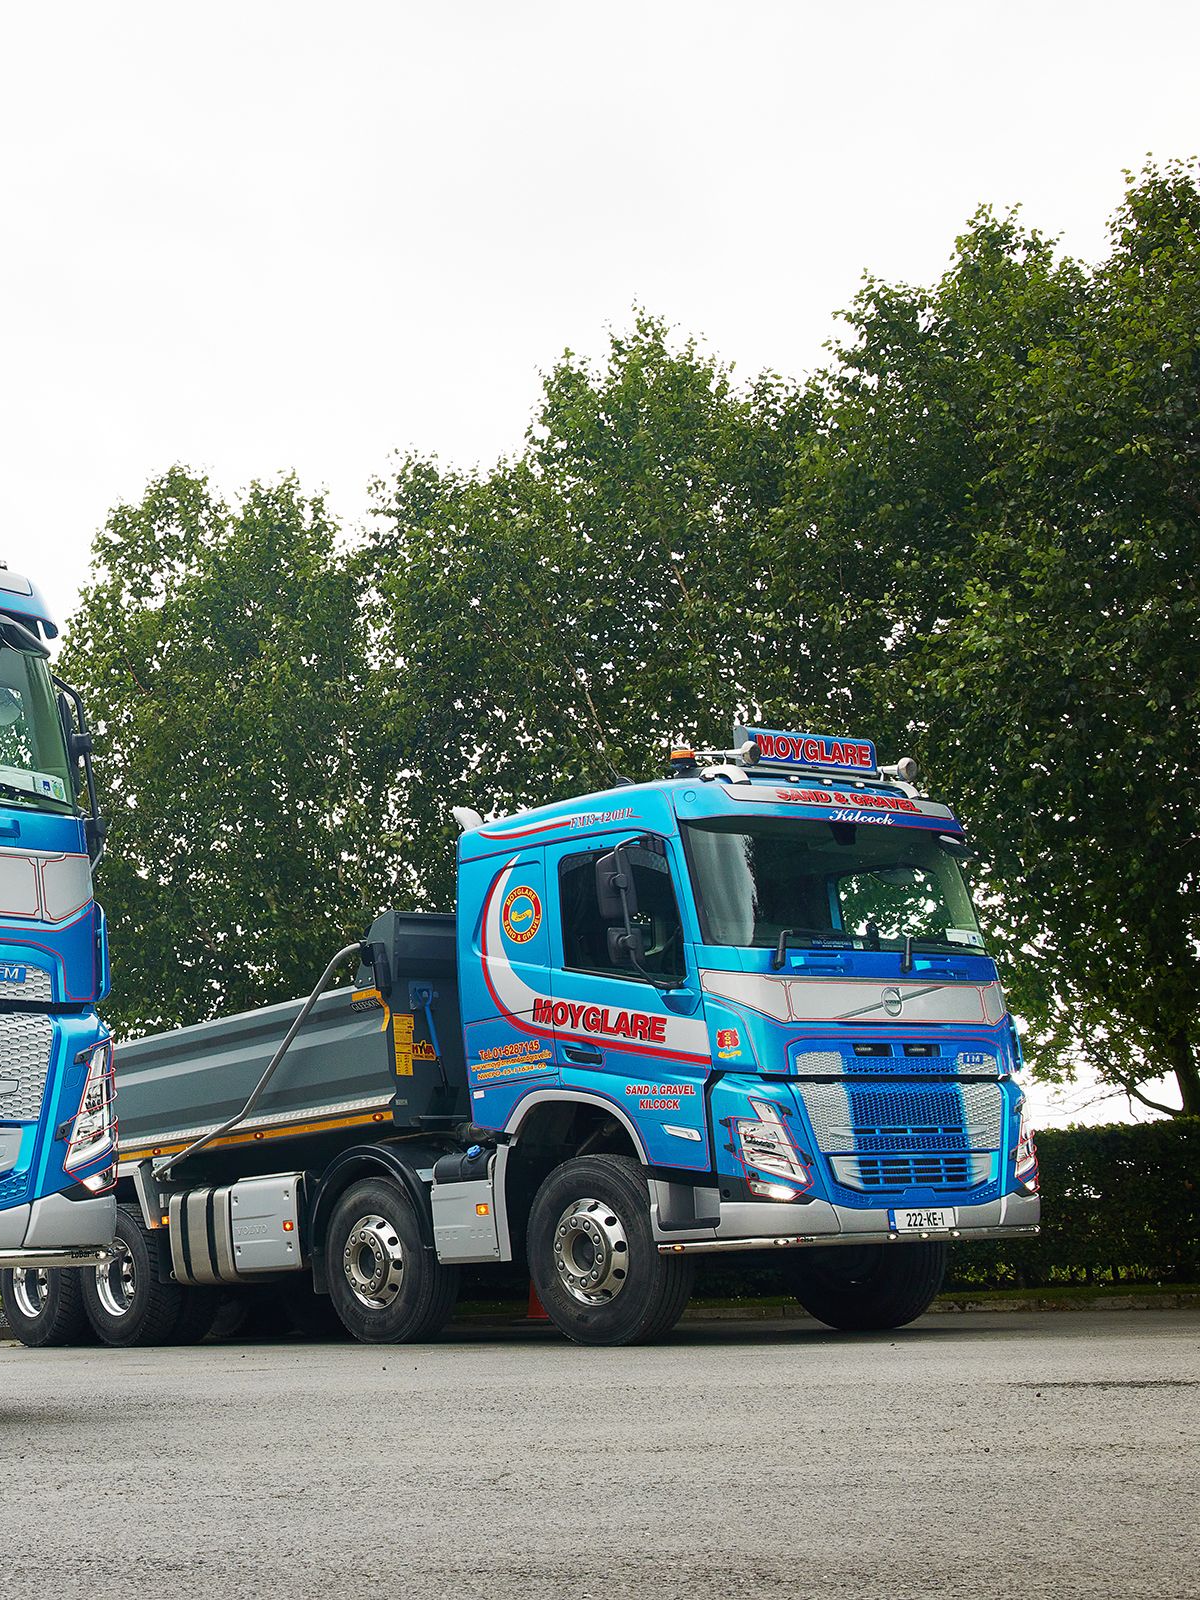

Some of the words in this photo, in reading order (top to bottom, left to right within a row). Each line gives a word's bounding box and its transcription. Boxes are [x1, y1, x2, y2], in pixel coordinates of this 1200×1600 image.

[756, 734, 872, 768] MOYGLARE
[776, 788, 832, 804] SAND
[833, 792, 850, 805] &
[850, 791, 922, 813] GRAVEL
[569, 807, 634, 830] FM13-420HP
[828, 808, 896, 825] Kilcock
[506, 887, 537, 907] MOYGLARE
[504, 920, 517, 940] SAND
[522, 914, 541, 941] GRAVEL
[350, 999, 381, 1011] GLEESON
[532, 998, 668, 1043] MOYGLARE
[411, 1041, 435, 1054] HYVA
[492, 1040, 540, 1058] 01-6287145
[625, 1085, 650, 1095] SAND
[651, 1085, 657, 1095] &
[659, 1084, 695, 1096] GRAVEL
[639, 1099, 680, 1110] KILCOCK
[906, 1212, 945, 1228] 222-KE-1
